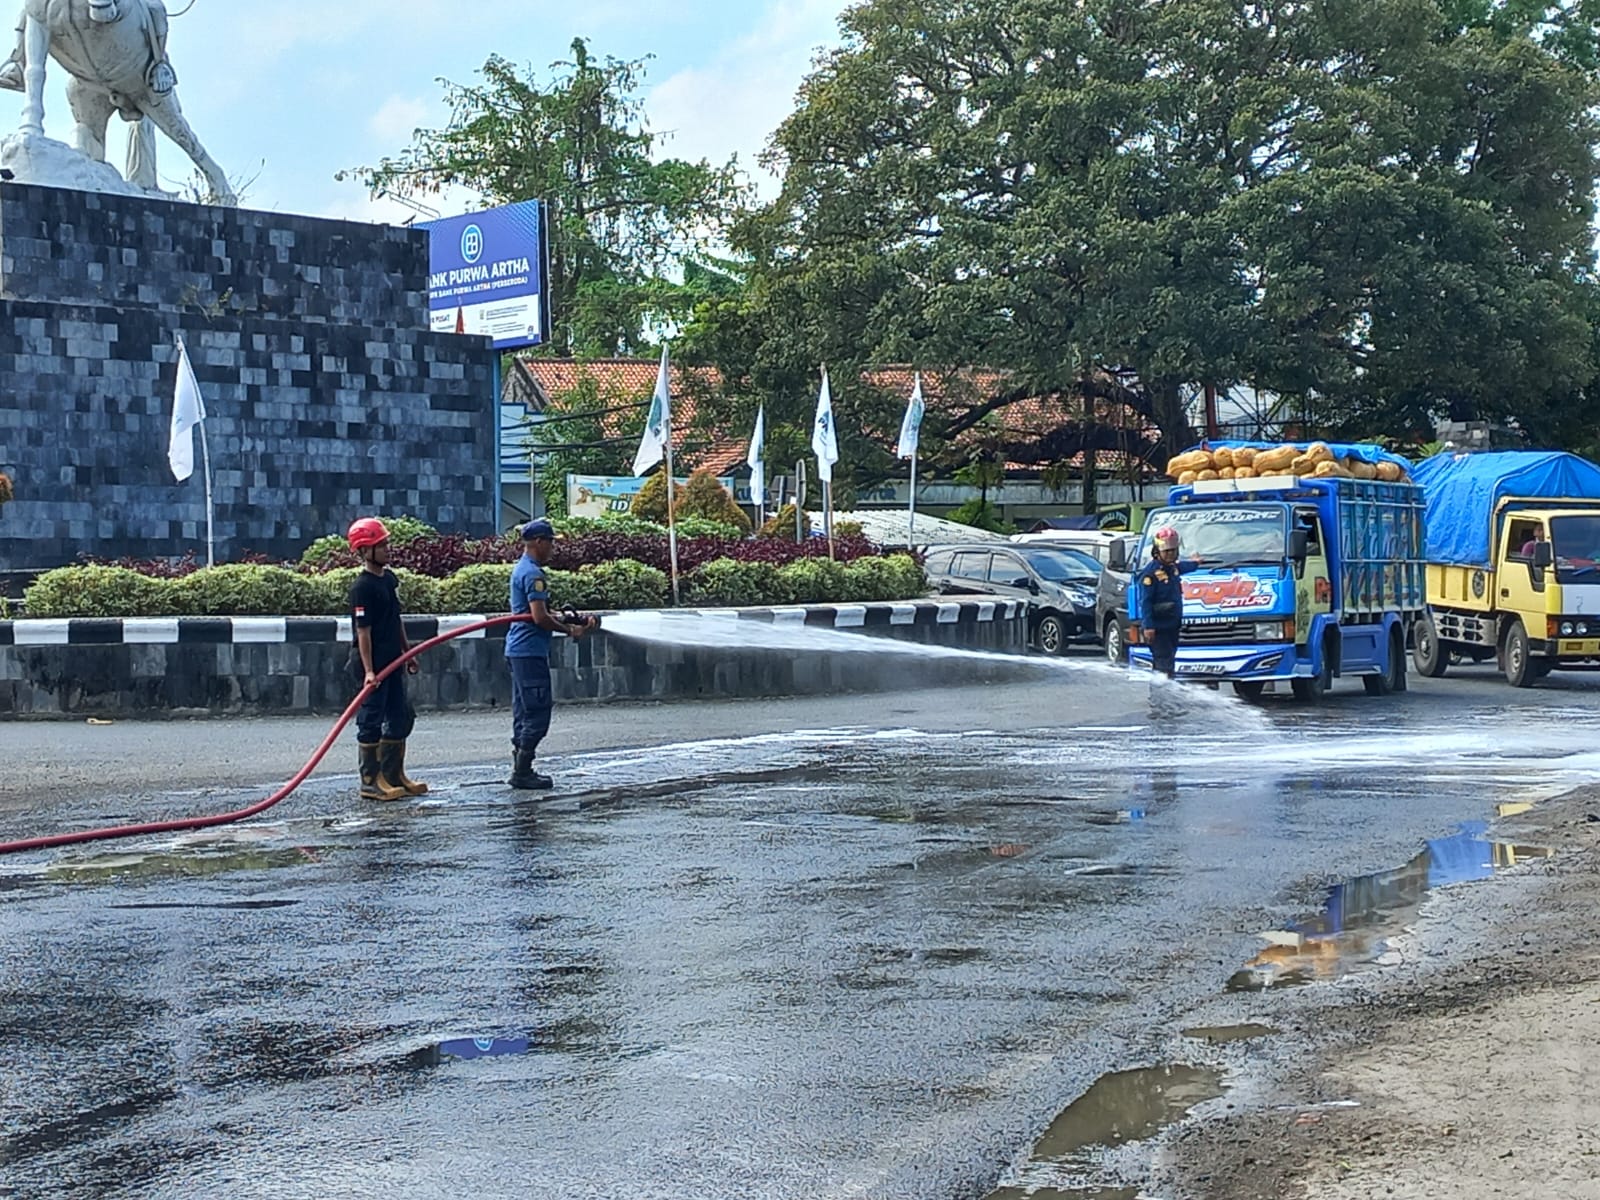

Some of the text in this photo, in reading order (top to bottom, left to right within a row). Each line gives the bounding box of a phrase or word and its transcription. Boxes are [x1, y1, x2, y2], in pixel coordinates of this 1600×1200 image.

[429, 257, 529, 288] ANK PURWA ARTHA
[473, 281, 490, 292] ARTHA
